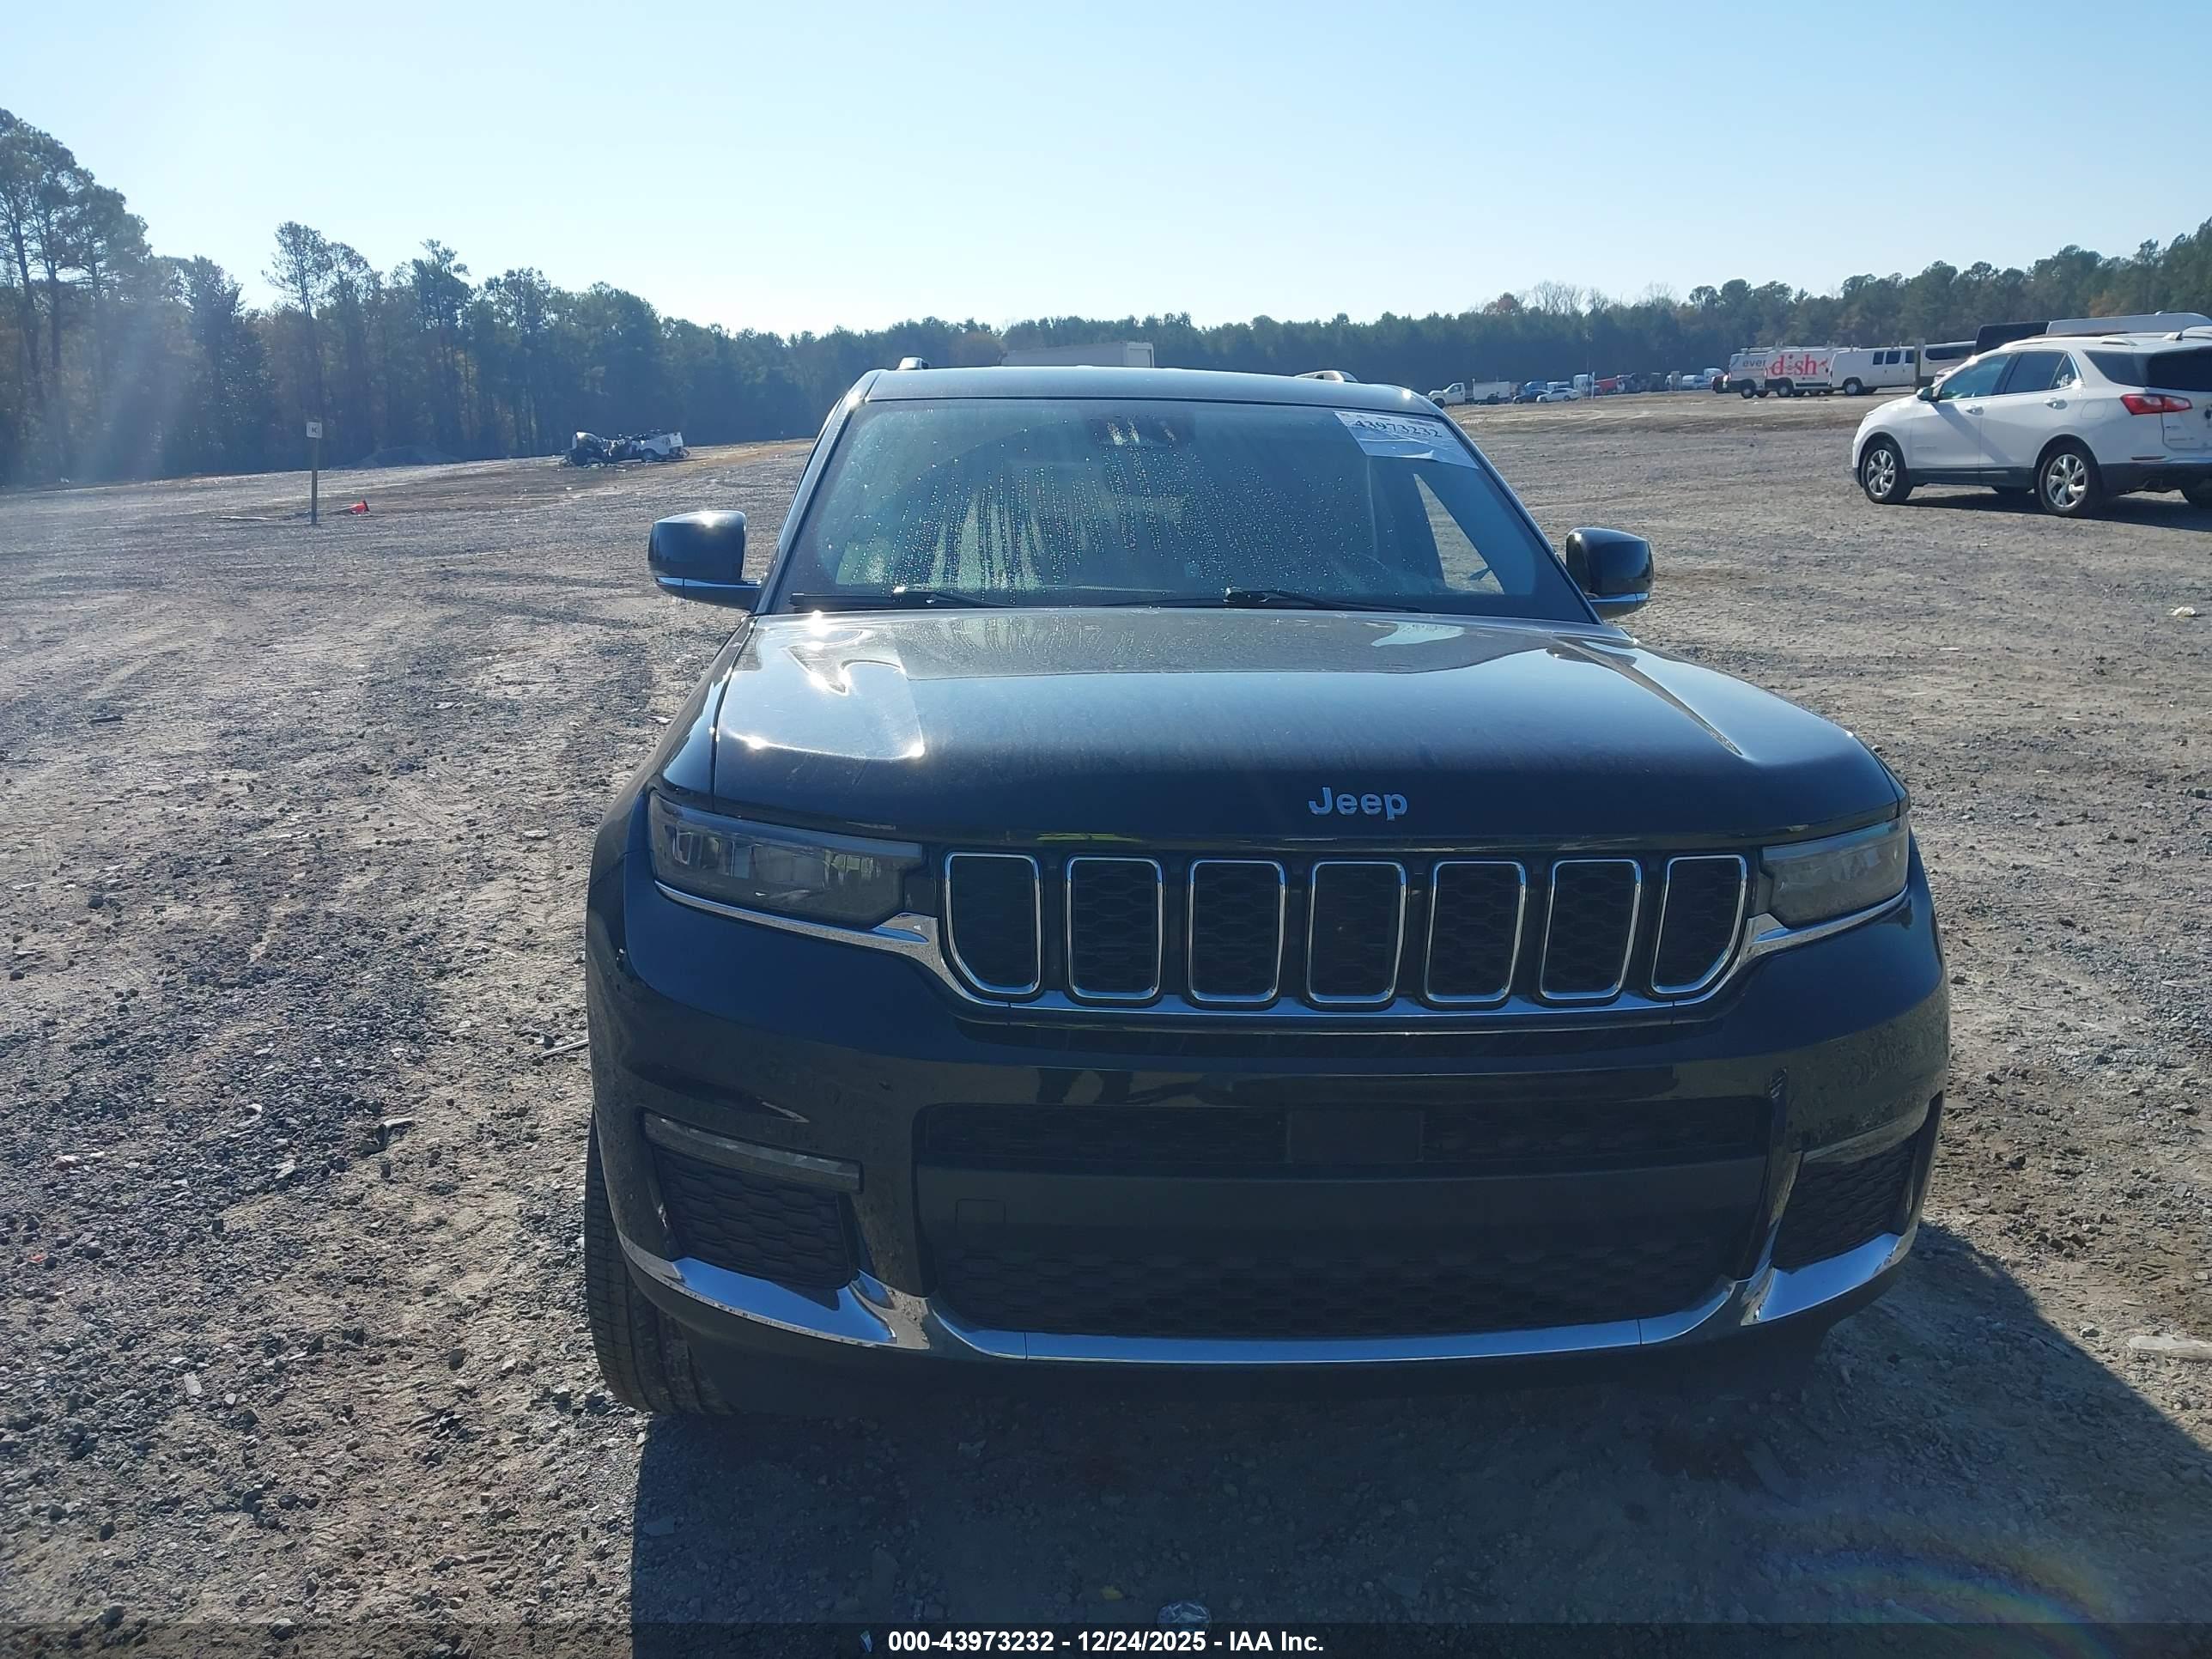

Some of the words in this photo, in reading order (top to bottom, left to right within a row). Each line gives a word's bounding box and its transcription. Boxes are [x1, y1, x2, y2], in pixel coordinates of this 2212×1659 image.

[1771, 354, 1817, 375] dish
[1352, 420, 1443, 438] 43973232
[1308, 787, 1408, 821] Jeep
